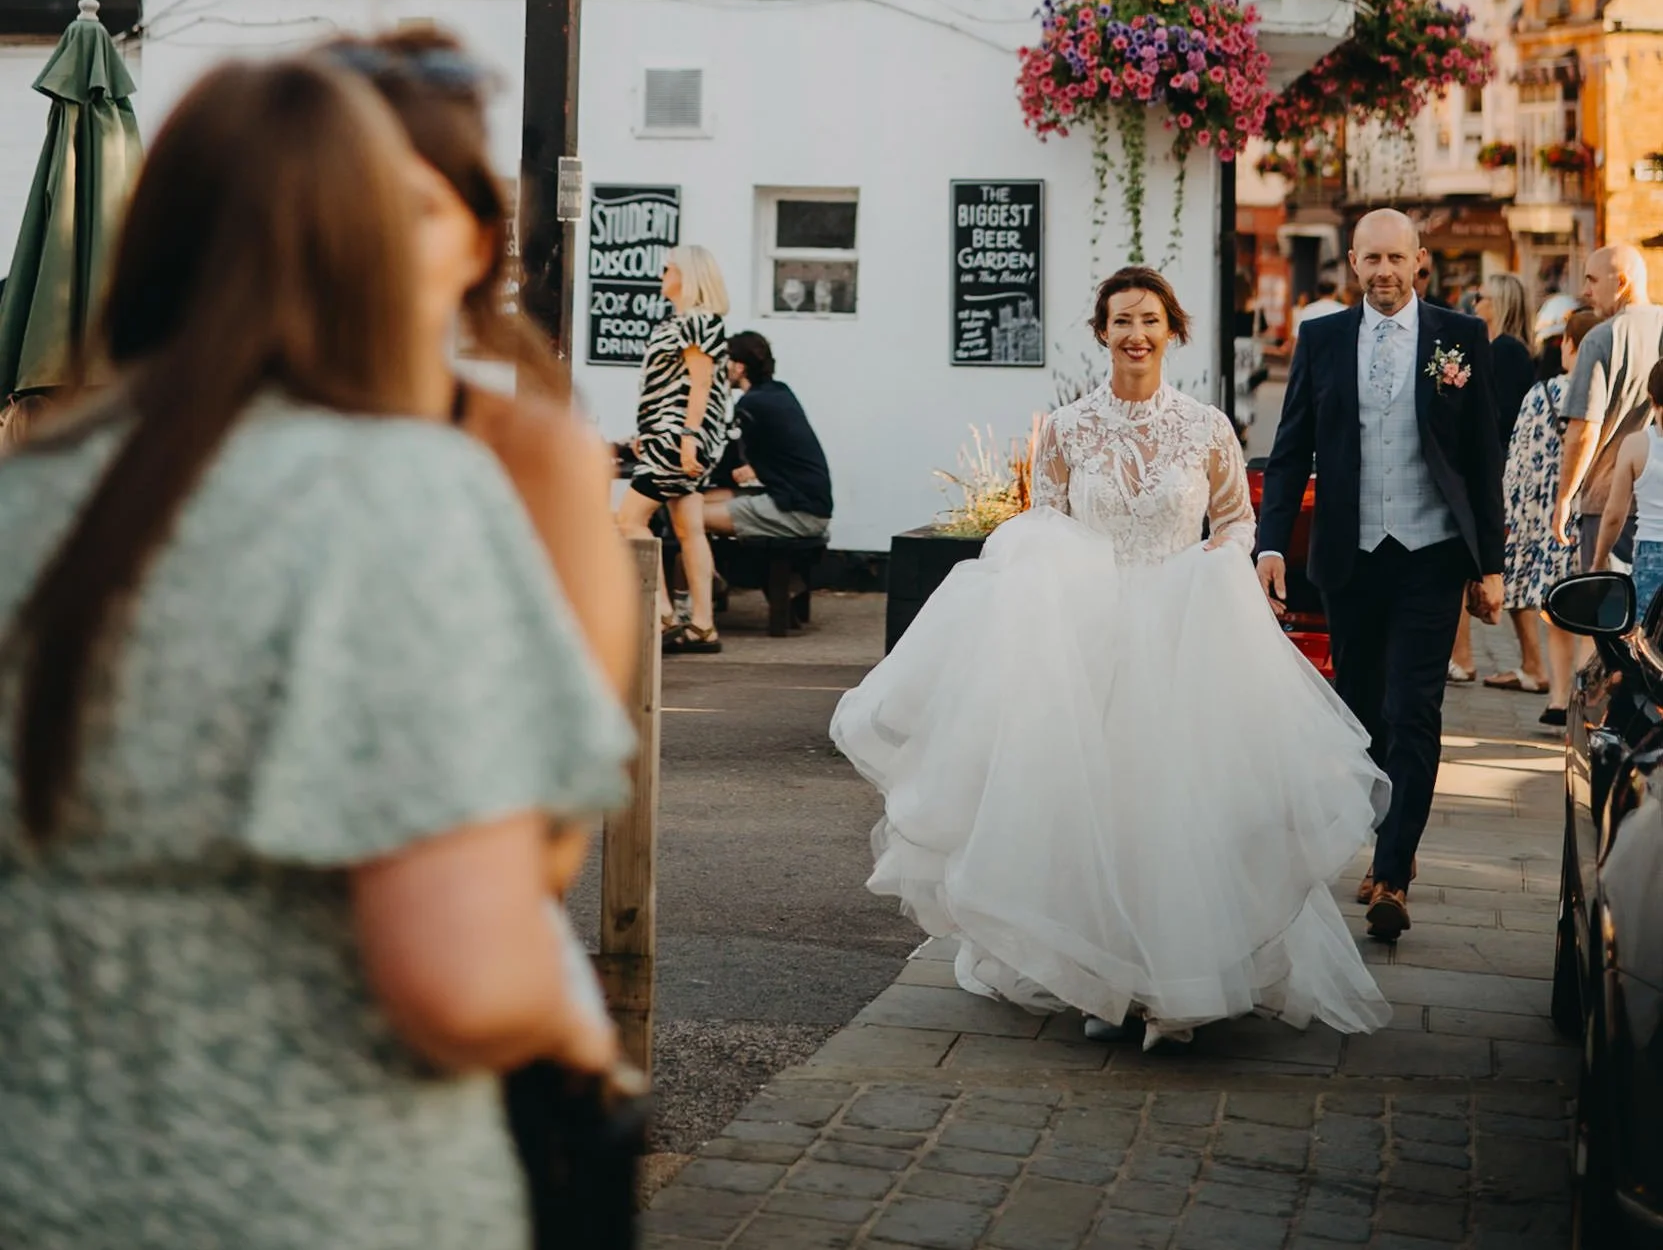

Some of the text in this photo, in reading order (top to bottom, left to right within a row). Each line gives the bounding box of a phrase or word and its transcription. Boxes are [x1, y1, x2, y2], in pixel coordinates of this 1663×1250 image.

[980, 185, 1011, 203] THE
[591, 201, 679, 246] STUDENT
[957, 203, 1034, 228] BIGGEST
[972, 227, 1023, 250] BEER
[957, 246, 1036, 271] GARDEN
[590, 290, 631, 317] 20%
[599, 318, 651, 337] FOOD
[596, 336, 647, 356] DRIN
